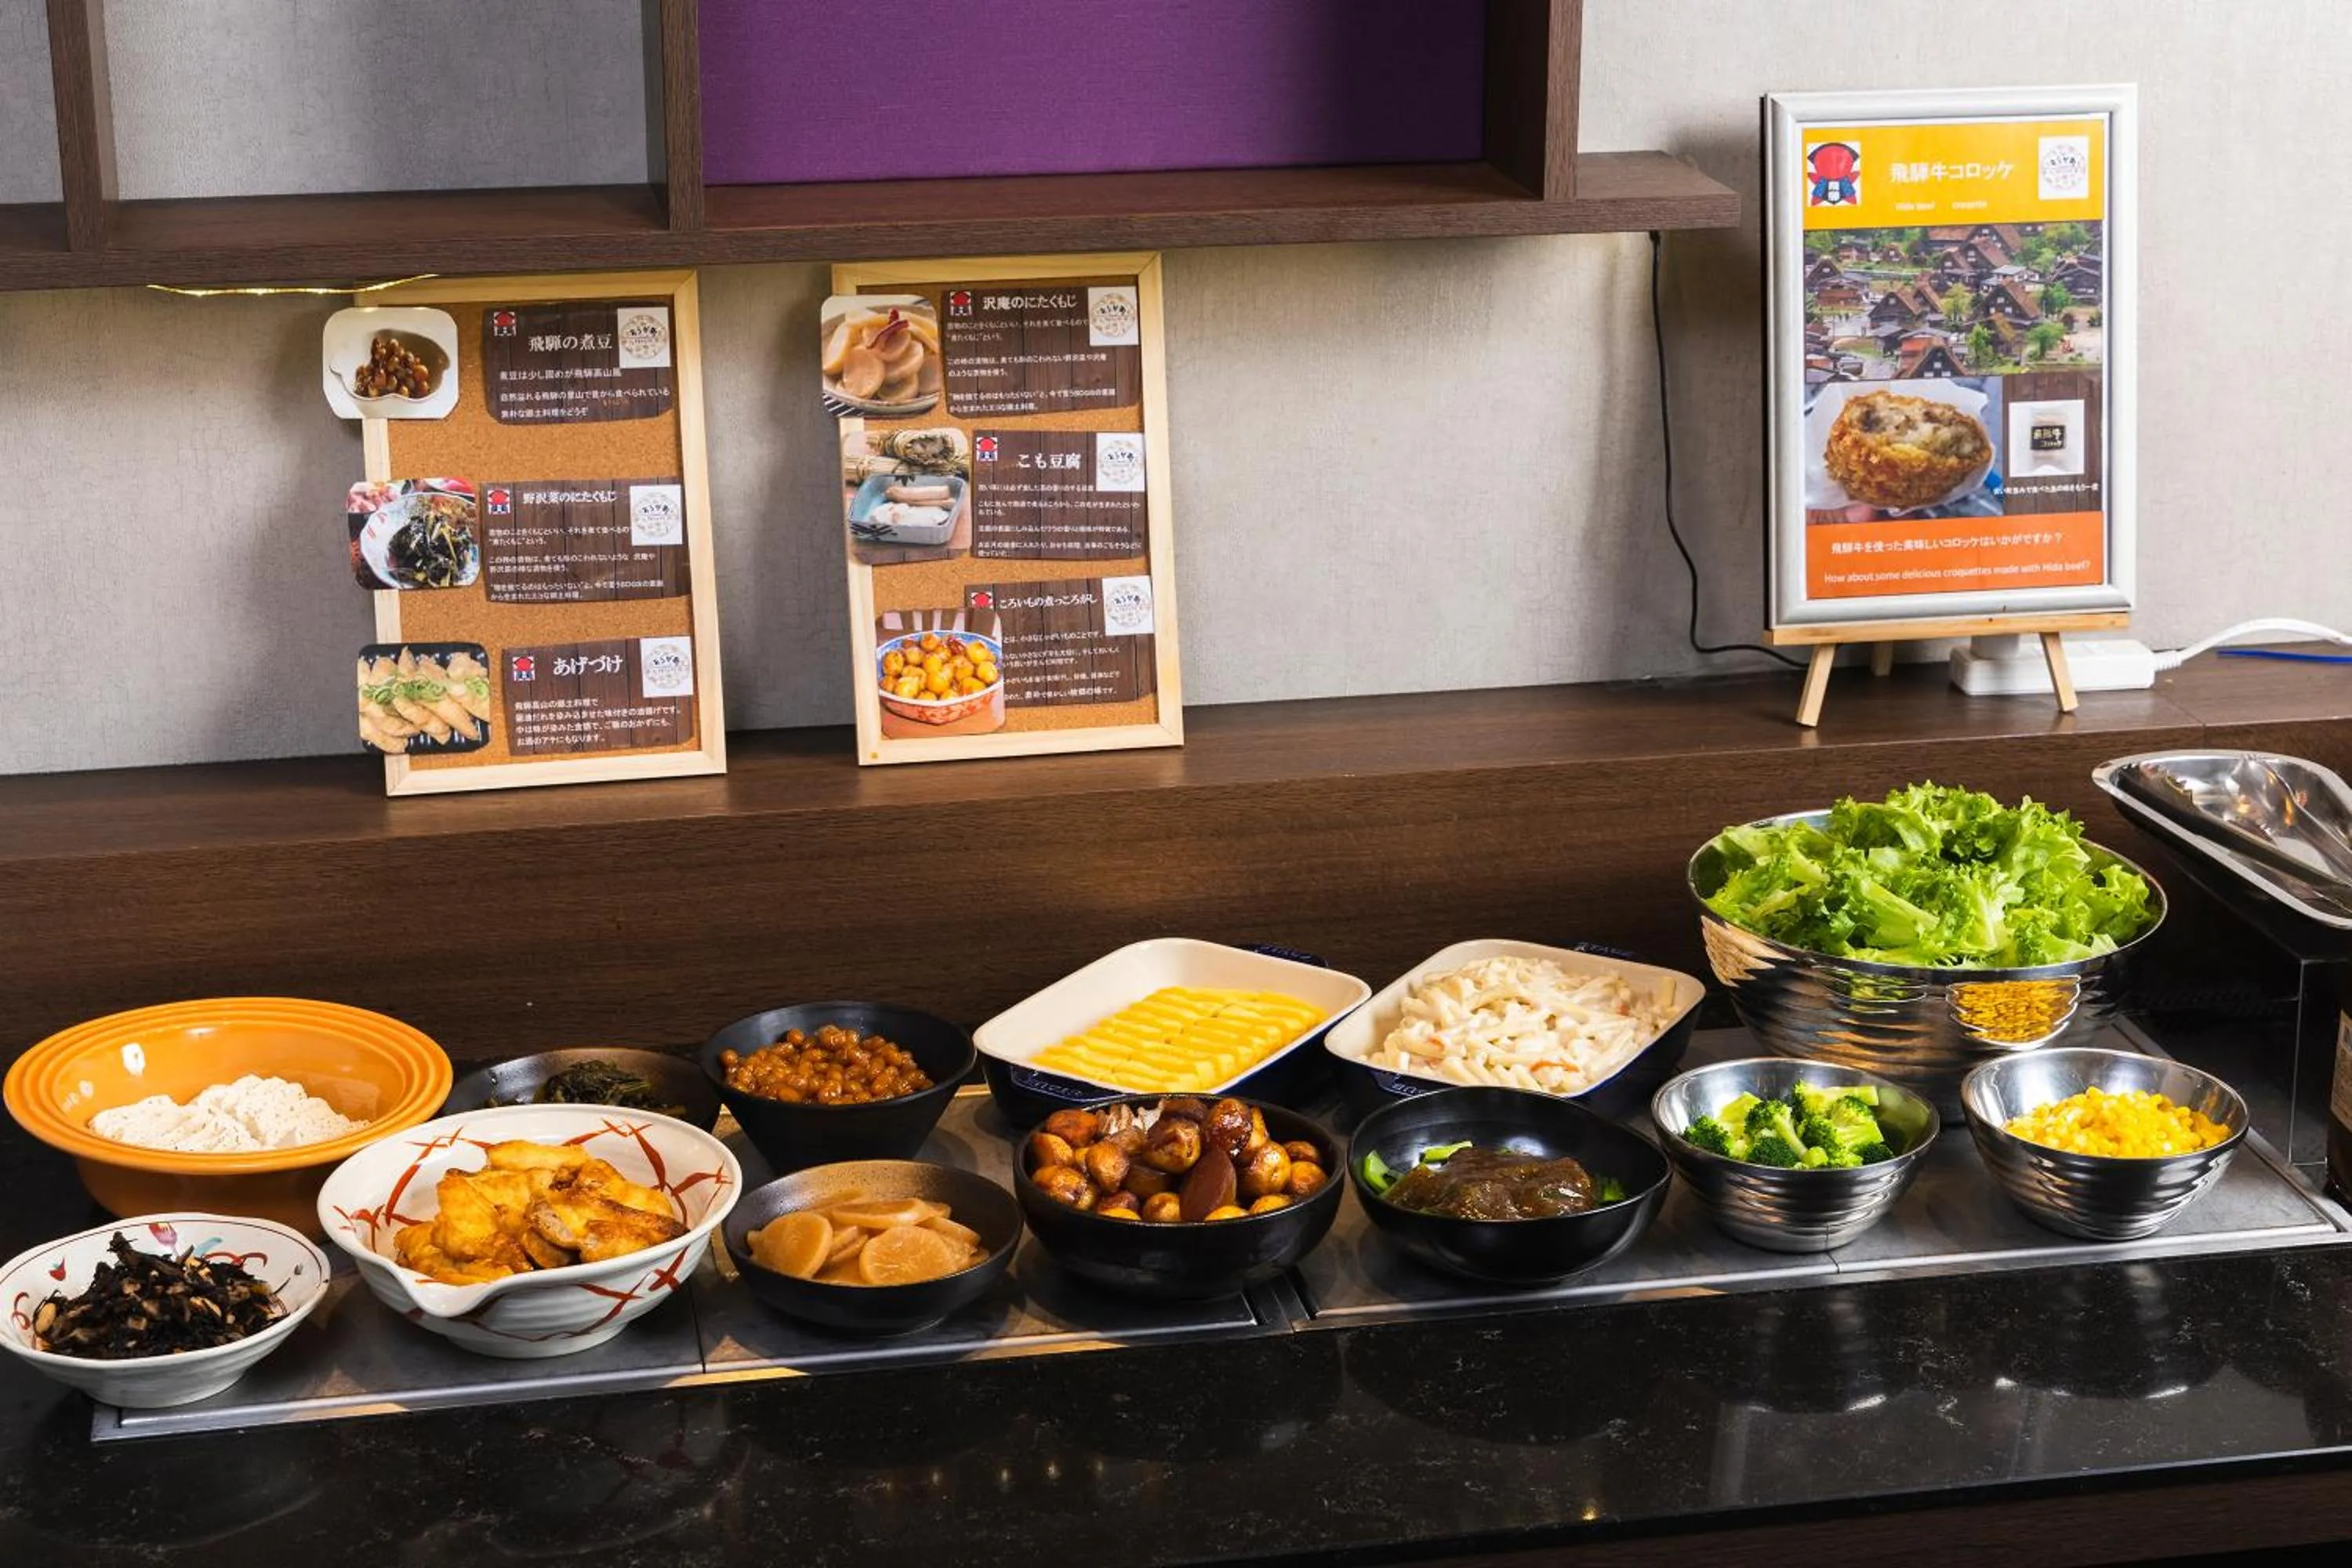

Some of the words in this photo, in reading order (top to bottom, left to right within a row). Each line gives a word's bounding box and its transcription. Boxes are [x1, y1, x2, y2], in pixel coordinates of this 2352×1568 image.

[1890, 161, 2014, 183] 飛騨牛コロッケ
[982, 294, 1077, 310] 沢庵のにたくもじ
[528, 333, 613, 352] 飛騨の煮豆
[1018, 452, 1081, 469] こも豆腐
[523, 490, 618, 505] 野沢菜のにたくもじ
[1824, 572, 1845, 583] How
[1847, 570, 1873, 582] about
[1876, 571, 1900, 581] some
[1903, 566, 1941, 579] delicious
[1944, 567, 1991, 579] croquettes
[1994, 564, 2019, 575] made
[2021, 562, 2040, 573] with
[2042, 561, 2063, 572] Hida
[2065, 560, 2091, 572] beef?
[553, 655, 623, 677] あげづけ
